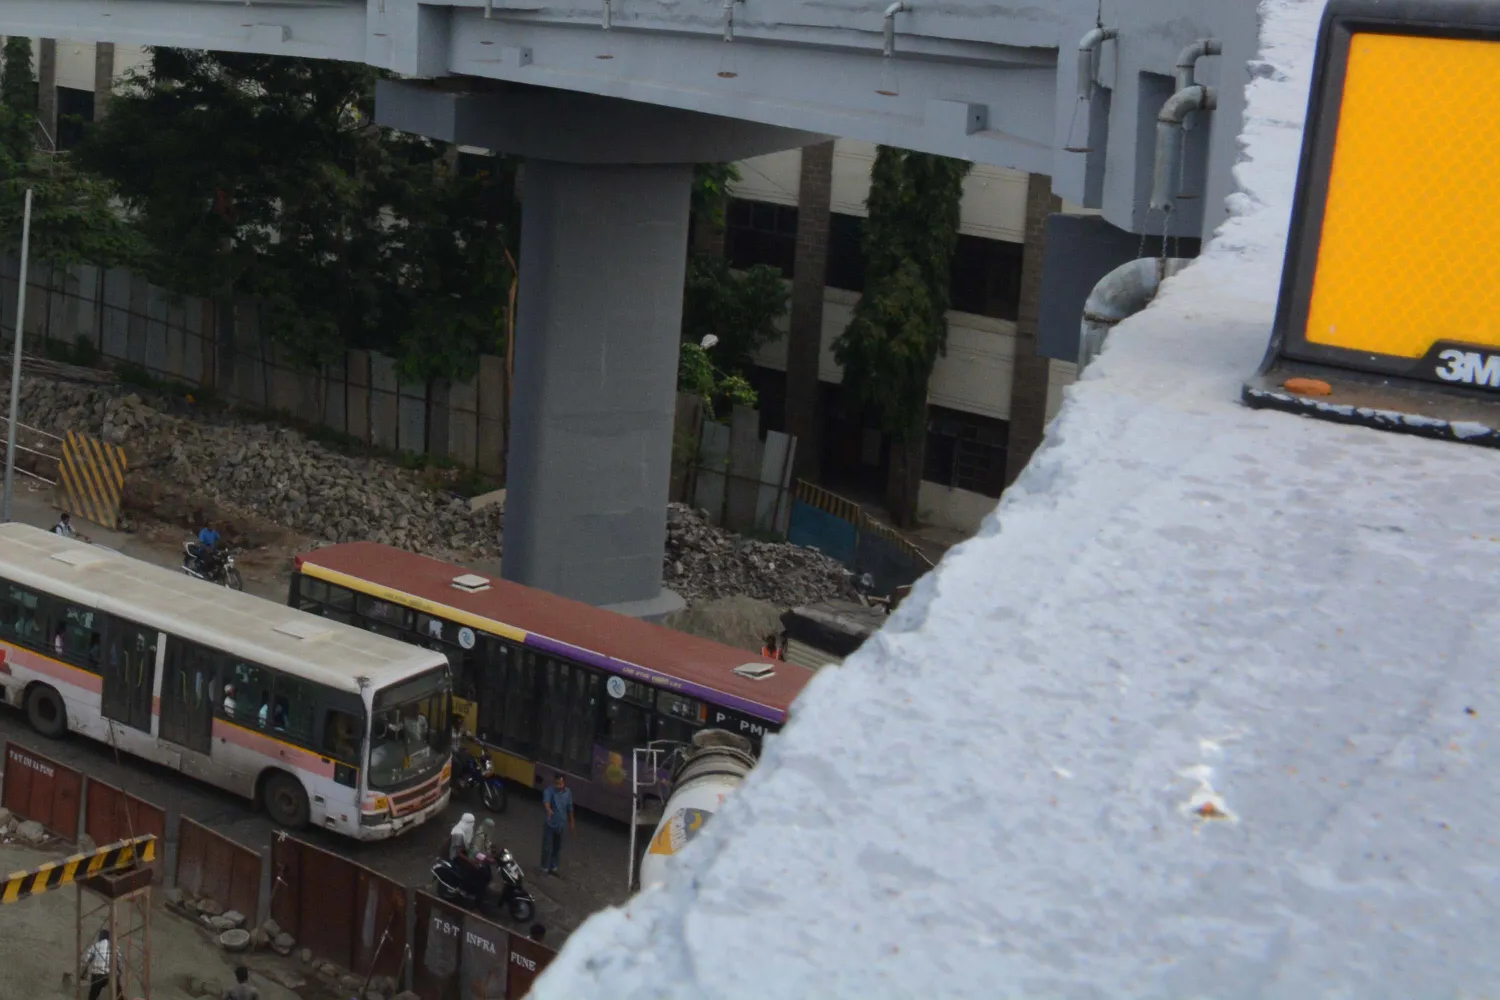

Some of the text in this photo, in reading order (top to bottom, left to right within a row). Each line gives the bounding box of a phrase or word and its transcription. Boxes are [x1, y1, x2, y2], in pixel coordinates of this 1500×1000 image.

[1435, 349, 1500, 388] 3M
[466, 931, 496, 955] INFRA
[511, 951, 537, 972] PUNE
